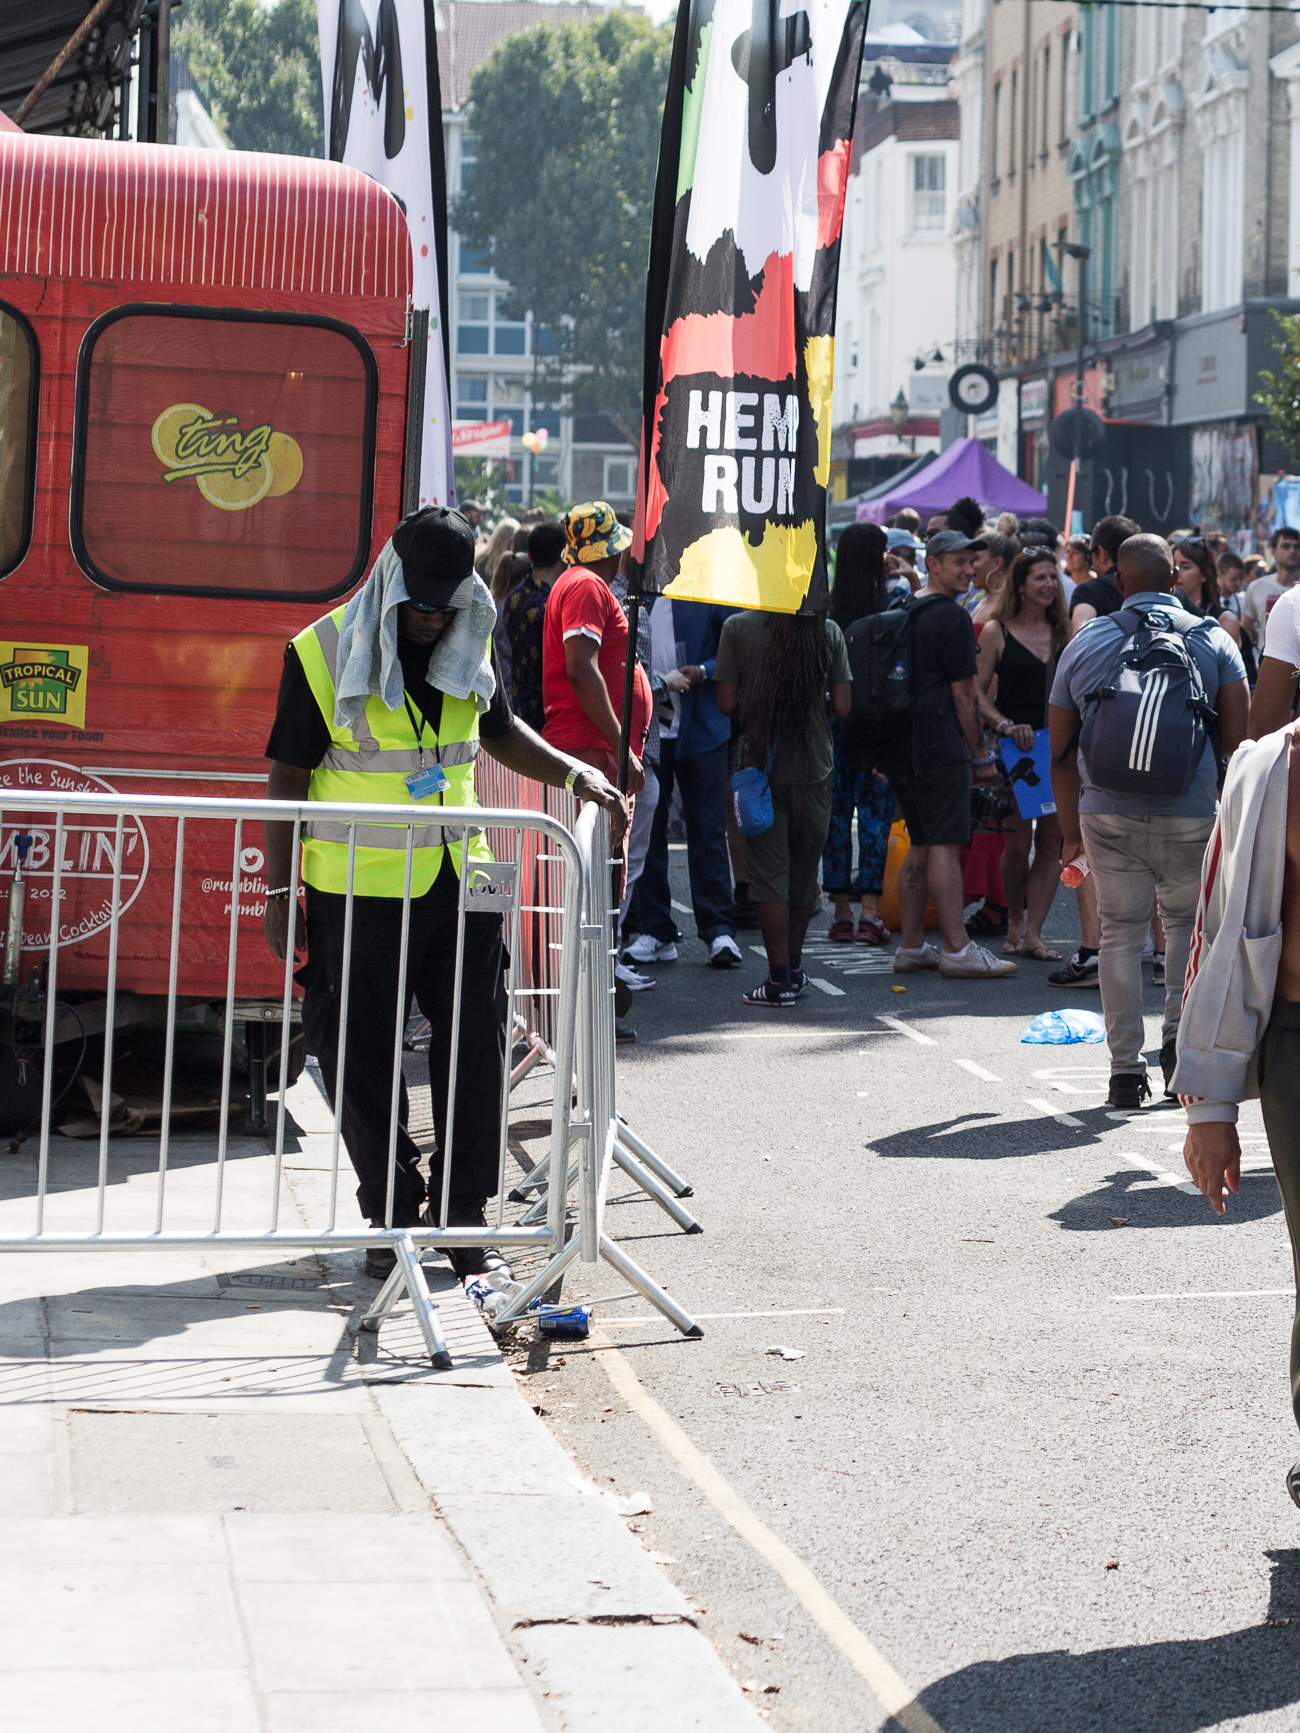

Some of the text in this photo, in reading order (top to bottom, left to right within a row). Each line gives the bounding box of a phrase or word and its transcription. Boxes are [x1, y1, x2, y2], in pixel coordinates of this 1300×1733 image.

[4, 664, 73, 684] TROPICAL
[16, 690, 61, 709] SUN
[41, 728, 69, 739] Your
[72, 730, 104, 742] Food!
[18, 766, 43, 784] the
